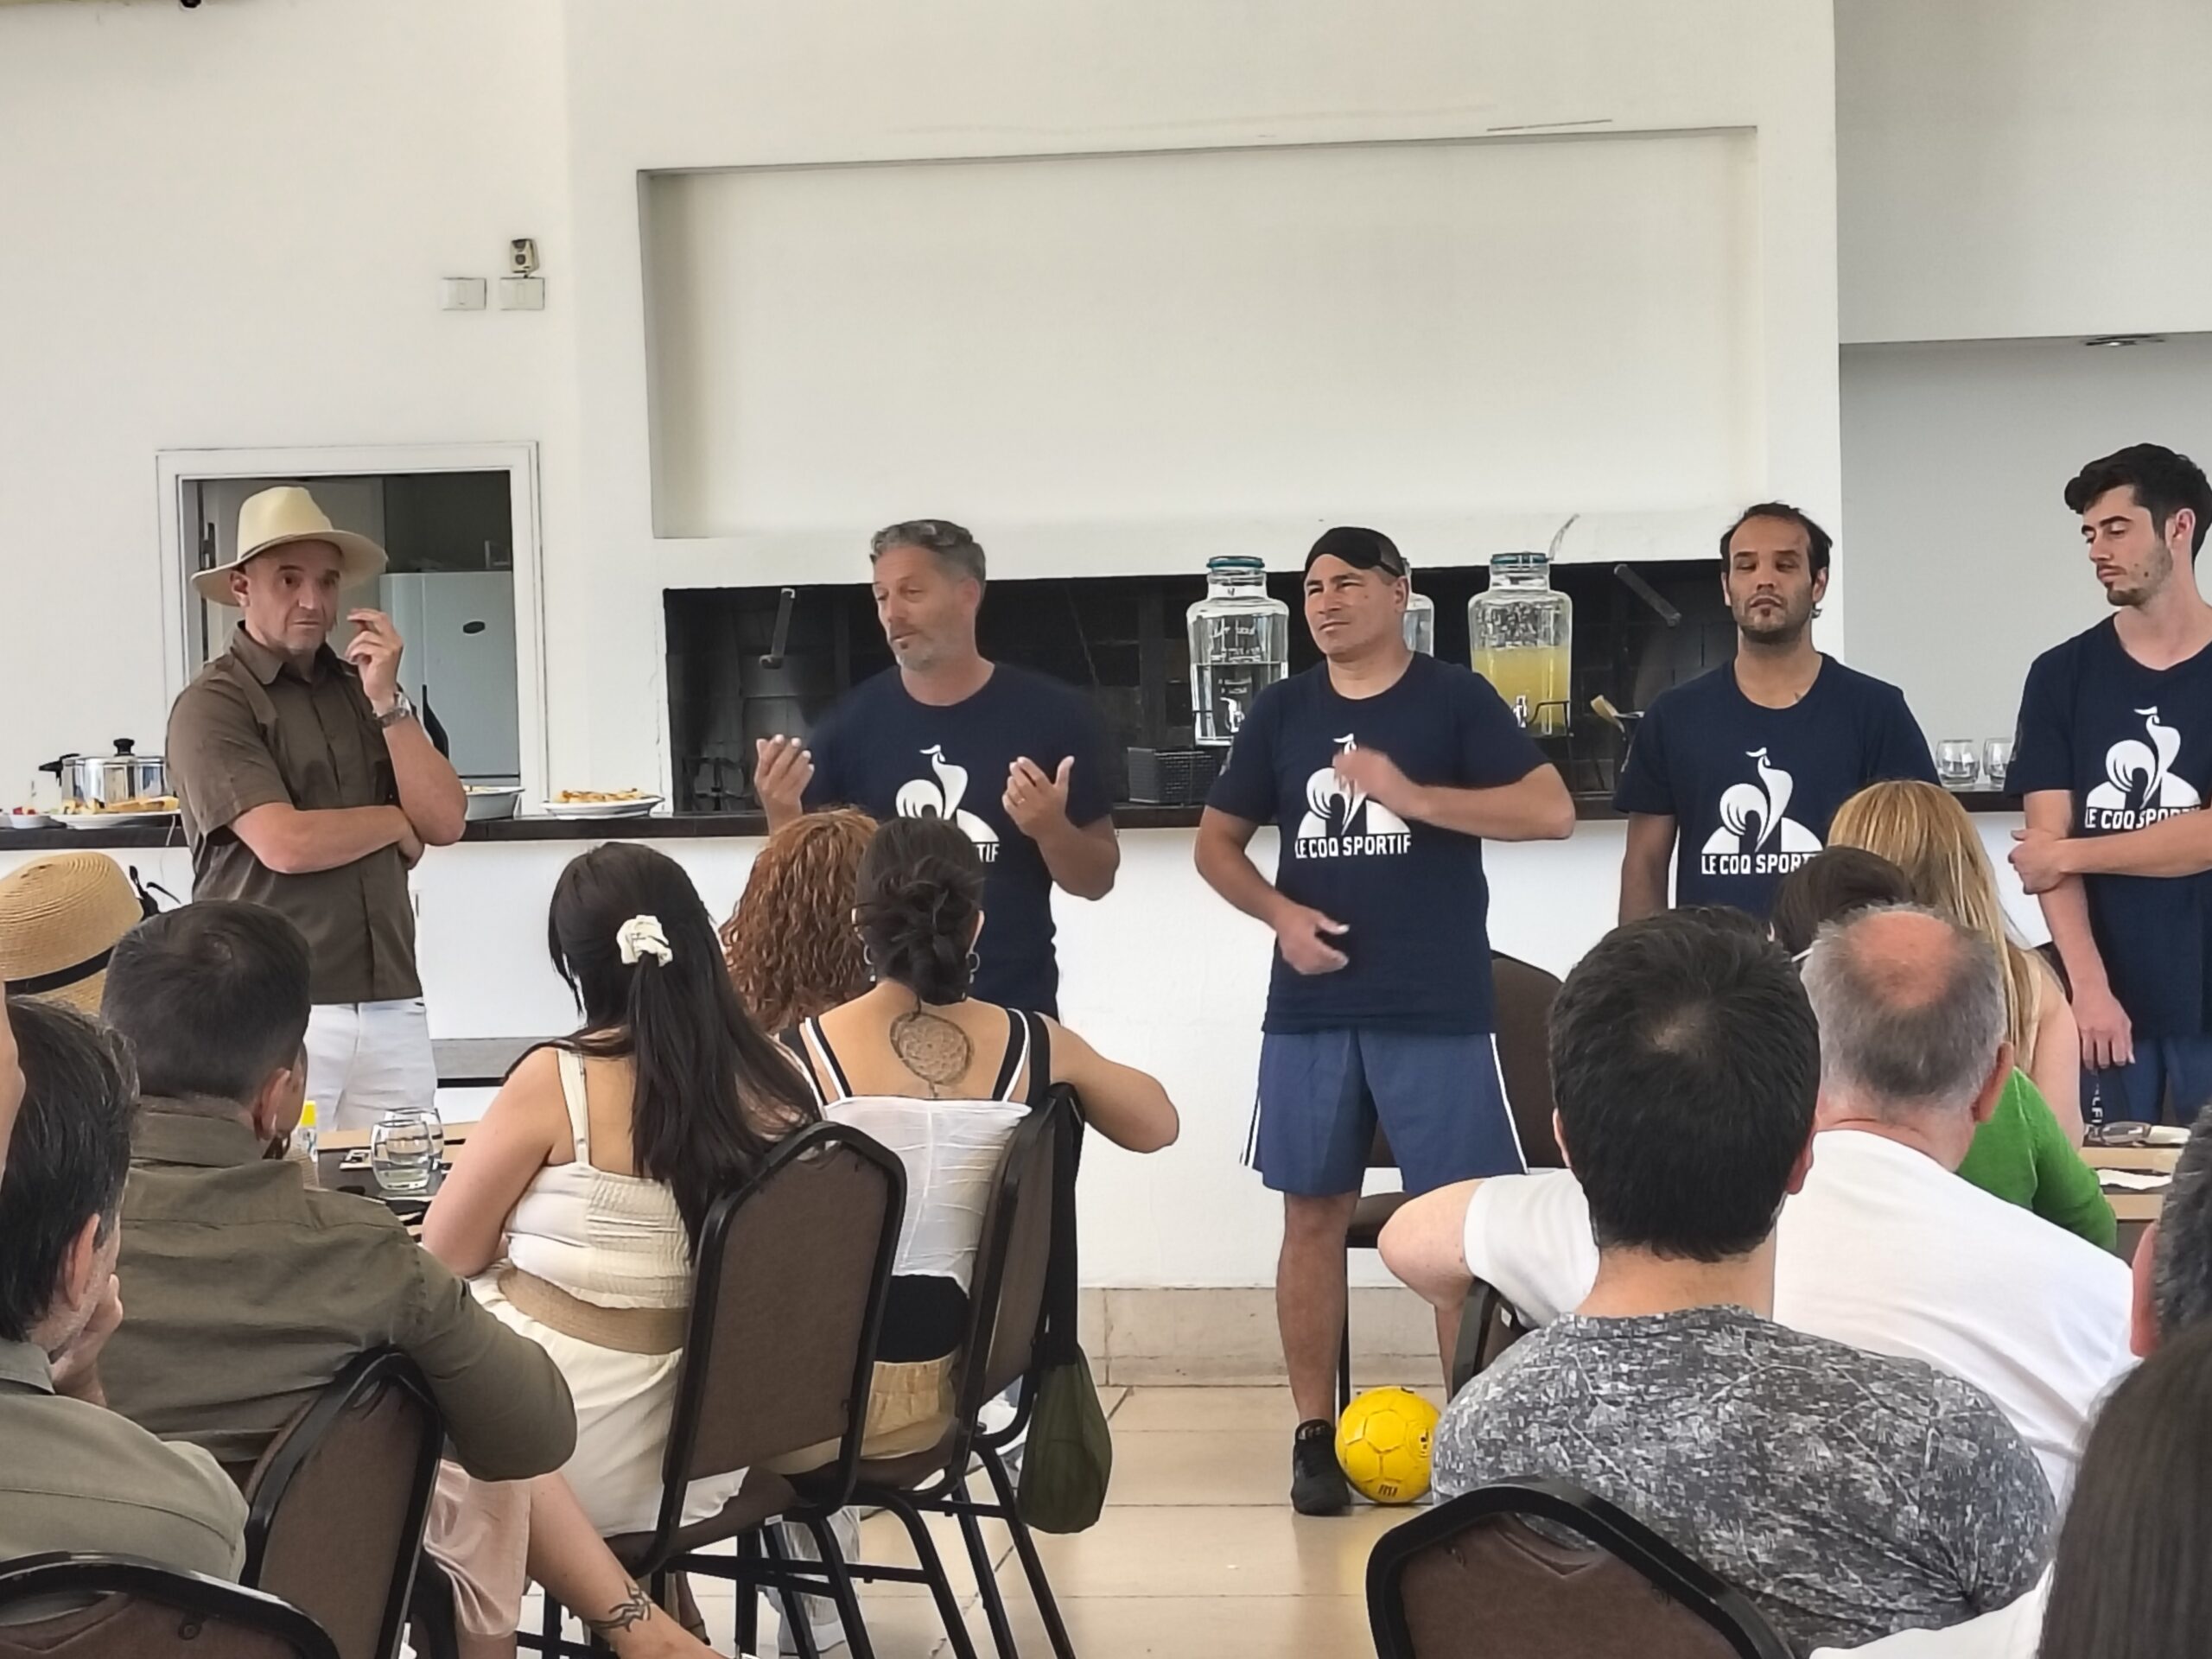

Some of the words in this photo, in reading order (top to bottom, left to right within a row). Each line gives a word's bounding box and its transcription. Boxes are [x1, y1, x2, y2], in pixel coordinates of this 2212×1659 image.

[2084, 808, 2097, 829] LE
[1294, 838, 1308, 859] LE
[1342, 834, 1411, 856] SPORTIF
[1701, 855, 1717, 874] LE
[1755, 853, 1818, 874] SPORT
